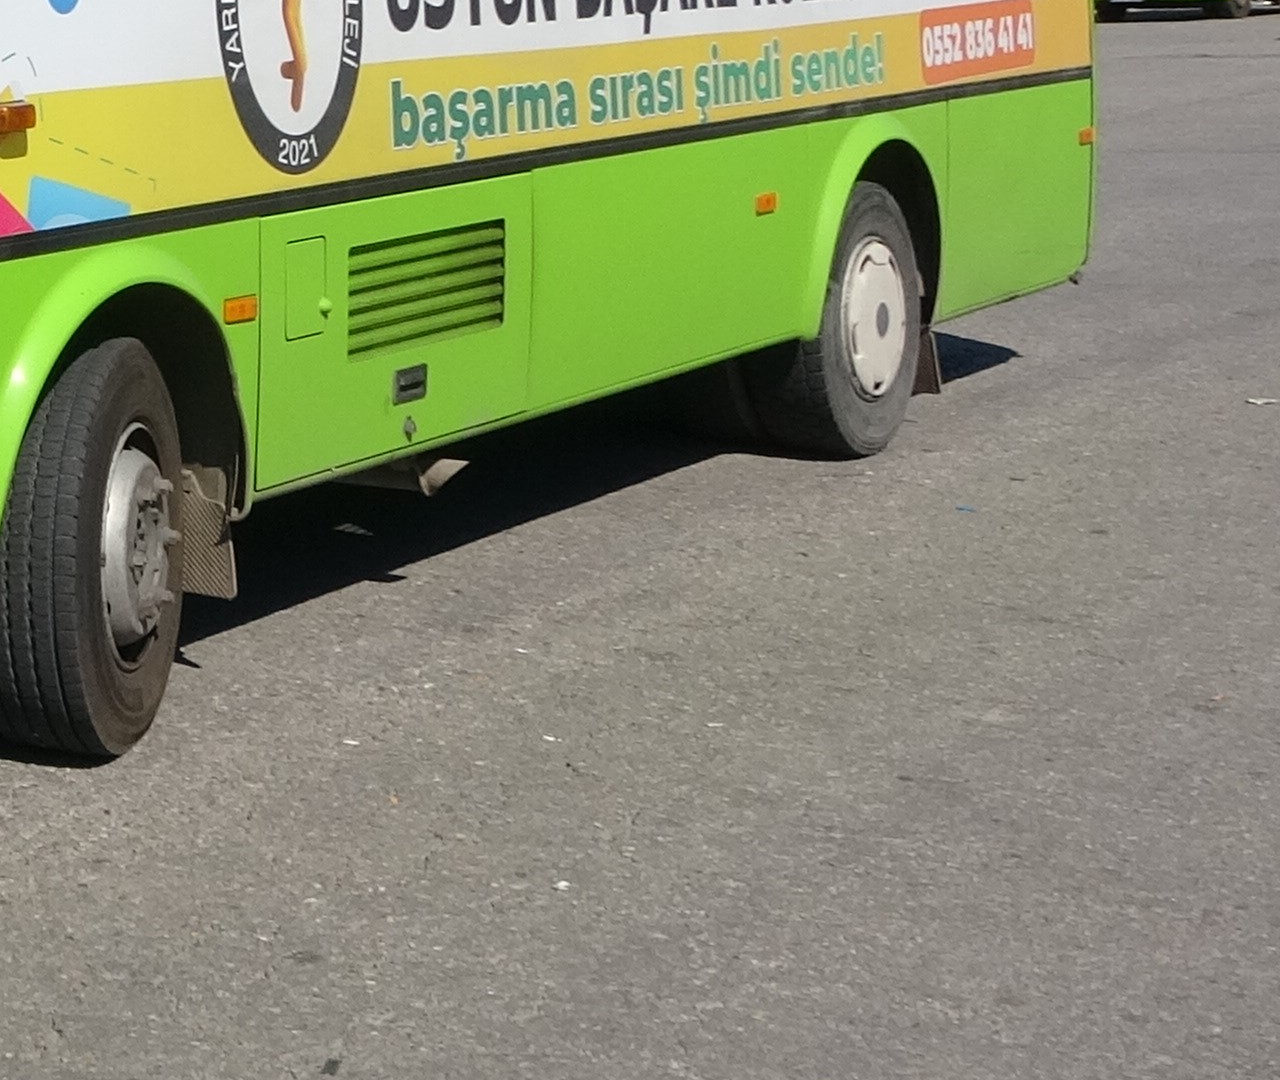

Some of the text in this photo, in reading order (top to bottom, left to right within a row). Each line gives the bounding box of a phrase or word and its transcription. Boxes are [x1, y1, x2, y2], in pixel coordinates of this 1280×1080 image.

[922, 12, 1034, 68] 0552 836 41 41
[390, 32, 885, 160] başarma sırası şimdi sende!
[278, 134, 320, 167] 2021
